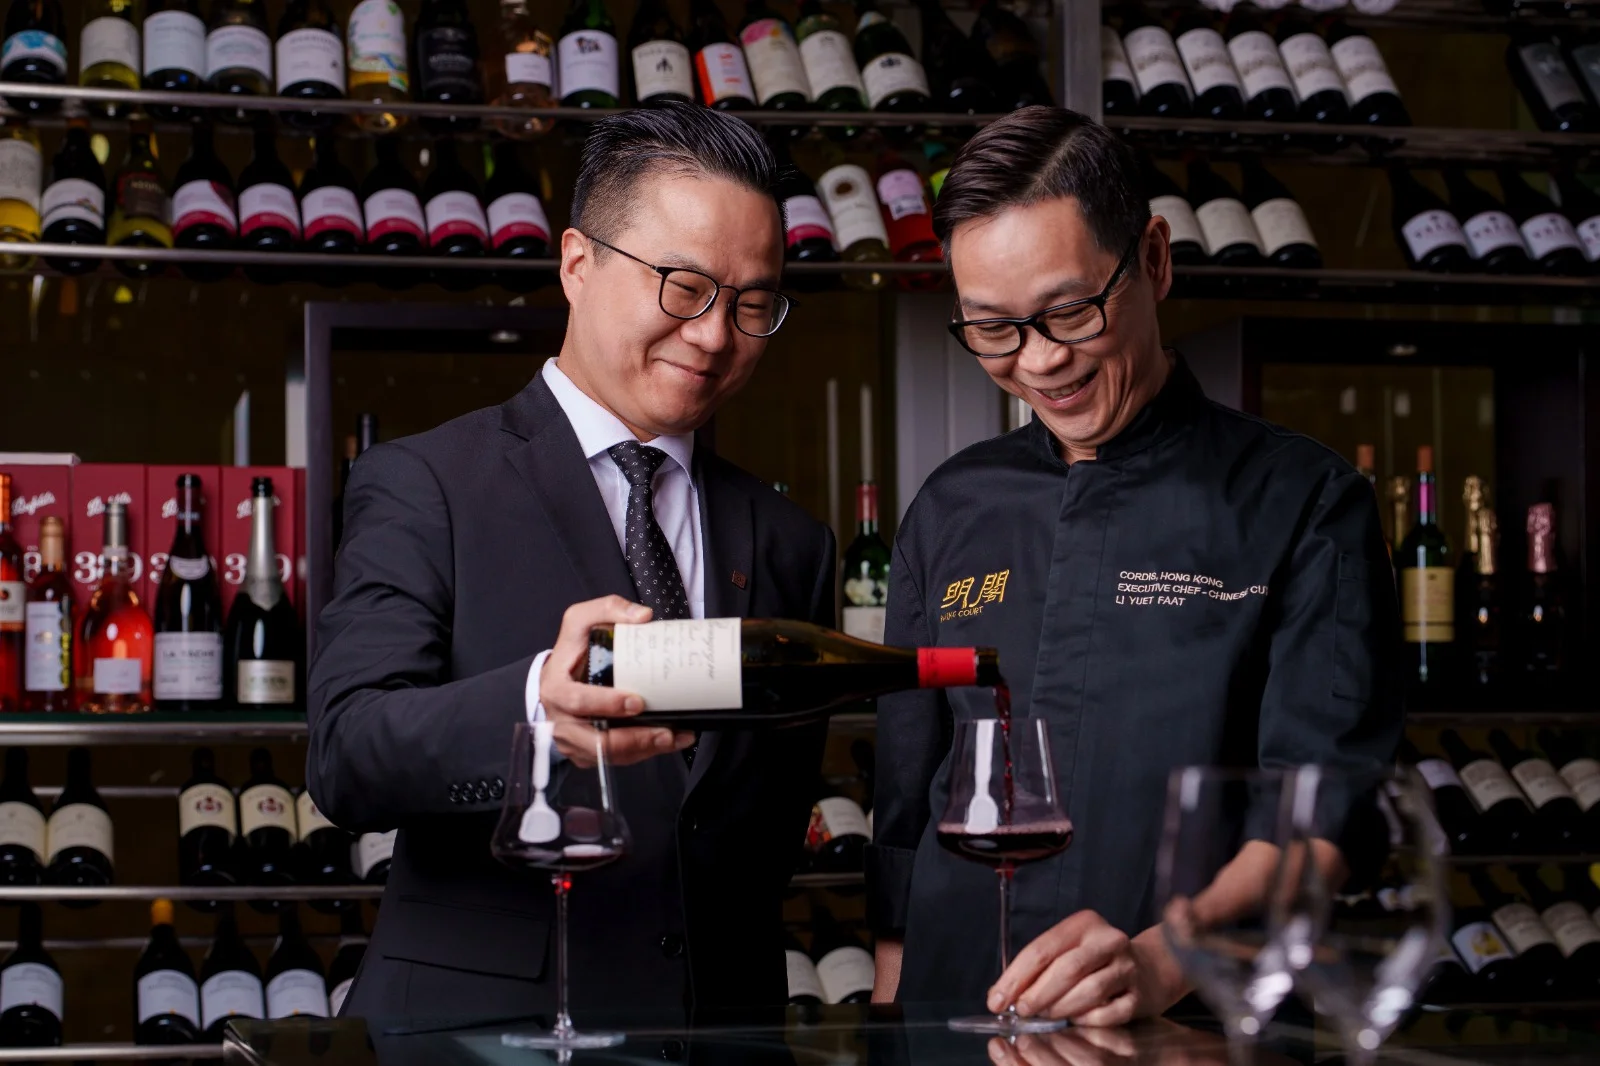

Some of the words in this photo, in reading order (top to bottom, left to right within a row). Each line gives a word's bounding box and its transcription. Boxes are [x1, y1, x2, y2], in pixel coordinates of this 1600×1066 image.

[1120, 571, 1158, 582] CORDIS,
[1159, 571, 1191, 582] HONG
[1192, 573, 1224, 588] KONG
[1117, 582, 1171, 593] EXECUTIVE
[1172, 584, 1202, 595] CHEF
[1115, 595, 1125, 605] LI
[1128, 596, 1154, 606] YUET
[1157, 595, 1187, 606] FAAT
[958, 606, 983, 616] COURT
